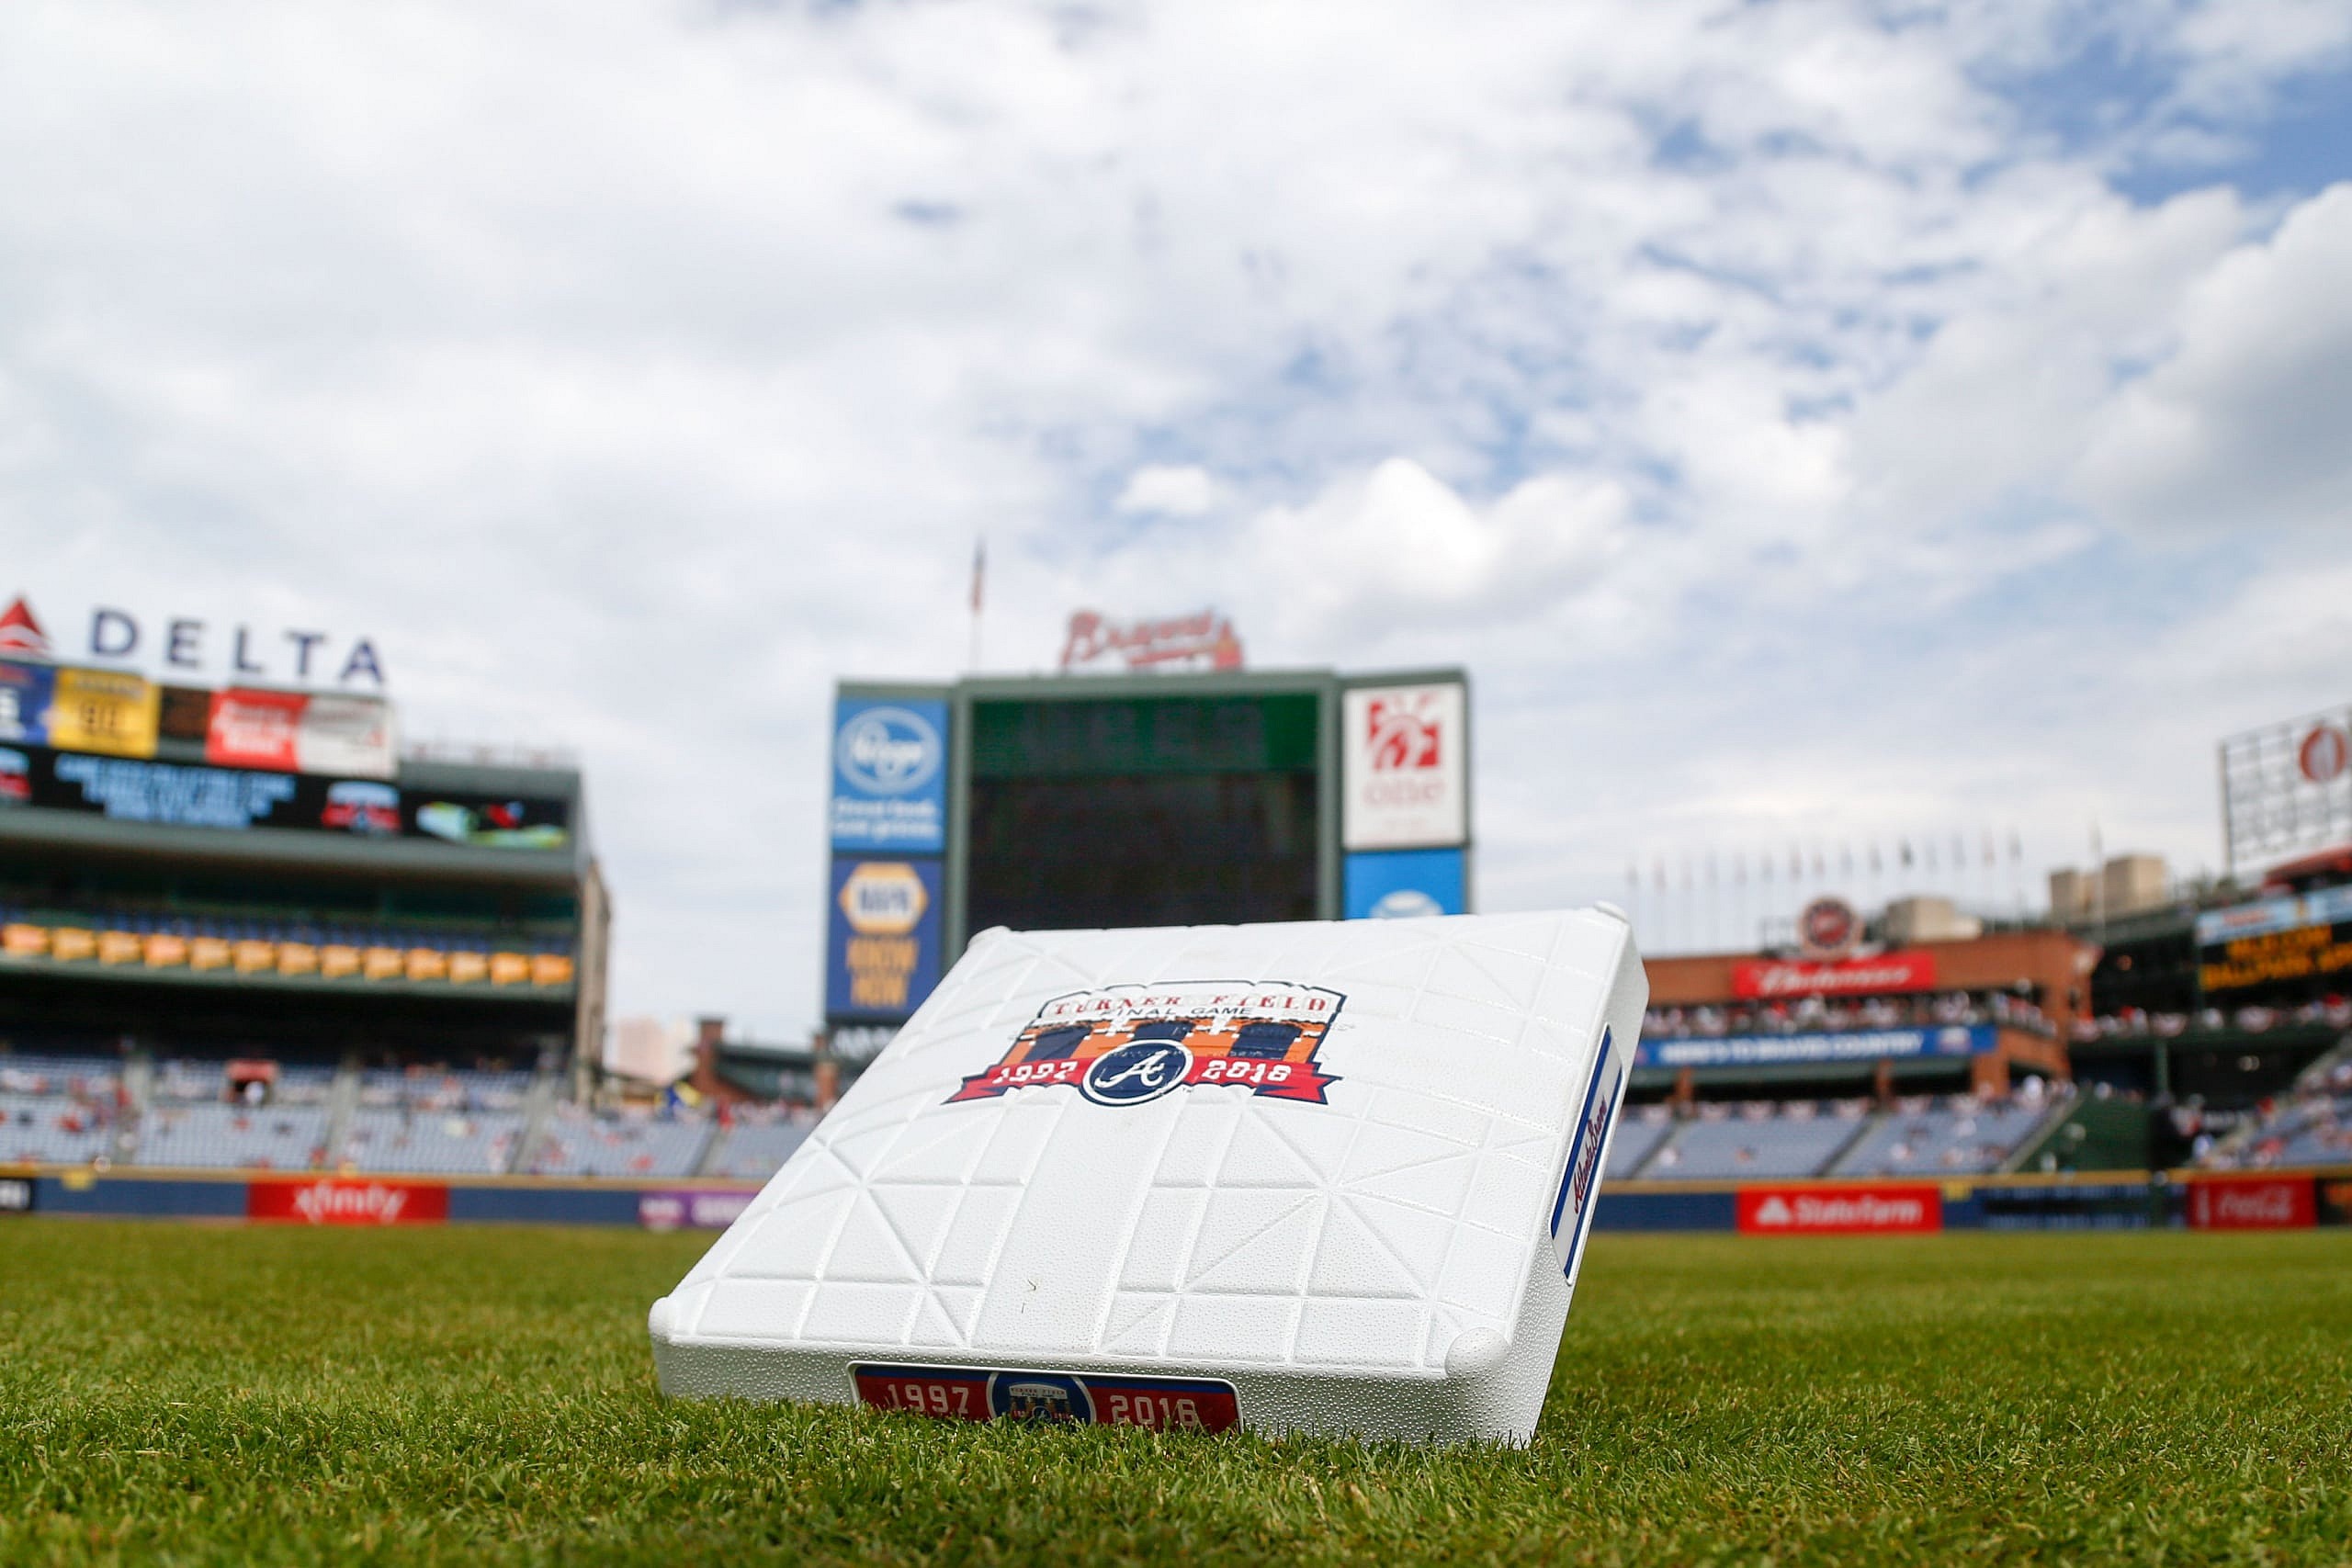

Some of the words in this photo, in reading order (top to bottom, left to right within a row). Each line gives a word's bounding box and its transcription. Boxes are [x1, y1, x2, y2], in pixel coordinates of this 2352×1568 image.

[90, 606, 388, 684] DELTA
[1056, 996, 1181, 1015] TURNER
[1212, 995, 1325, 1011] FIELD
[991, 1060, 1079, 1084] 1997
[1201, 1060, 1293, 1084] 2016
[295, 1181, 407, 1224] xfinity
[888, 1382, 968, 1415] 1997
[1110, 1394, 1198, 1427] 2016
